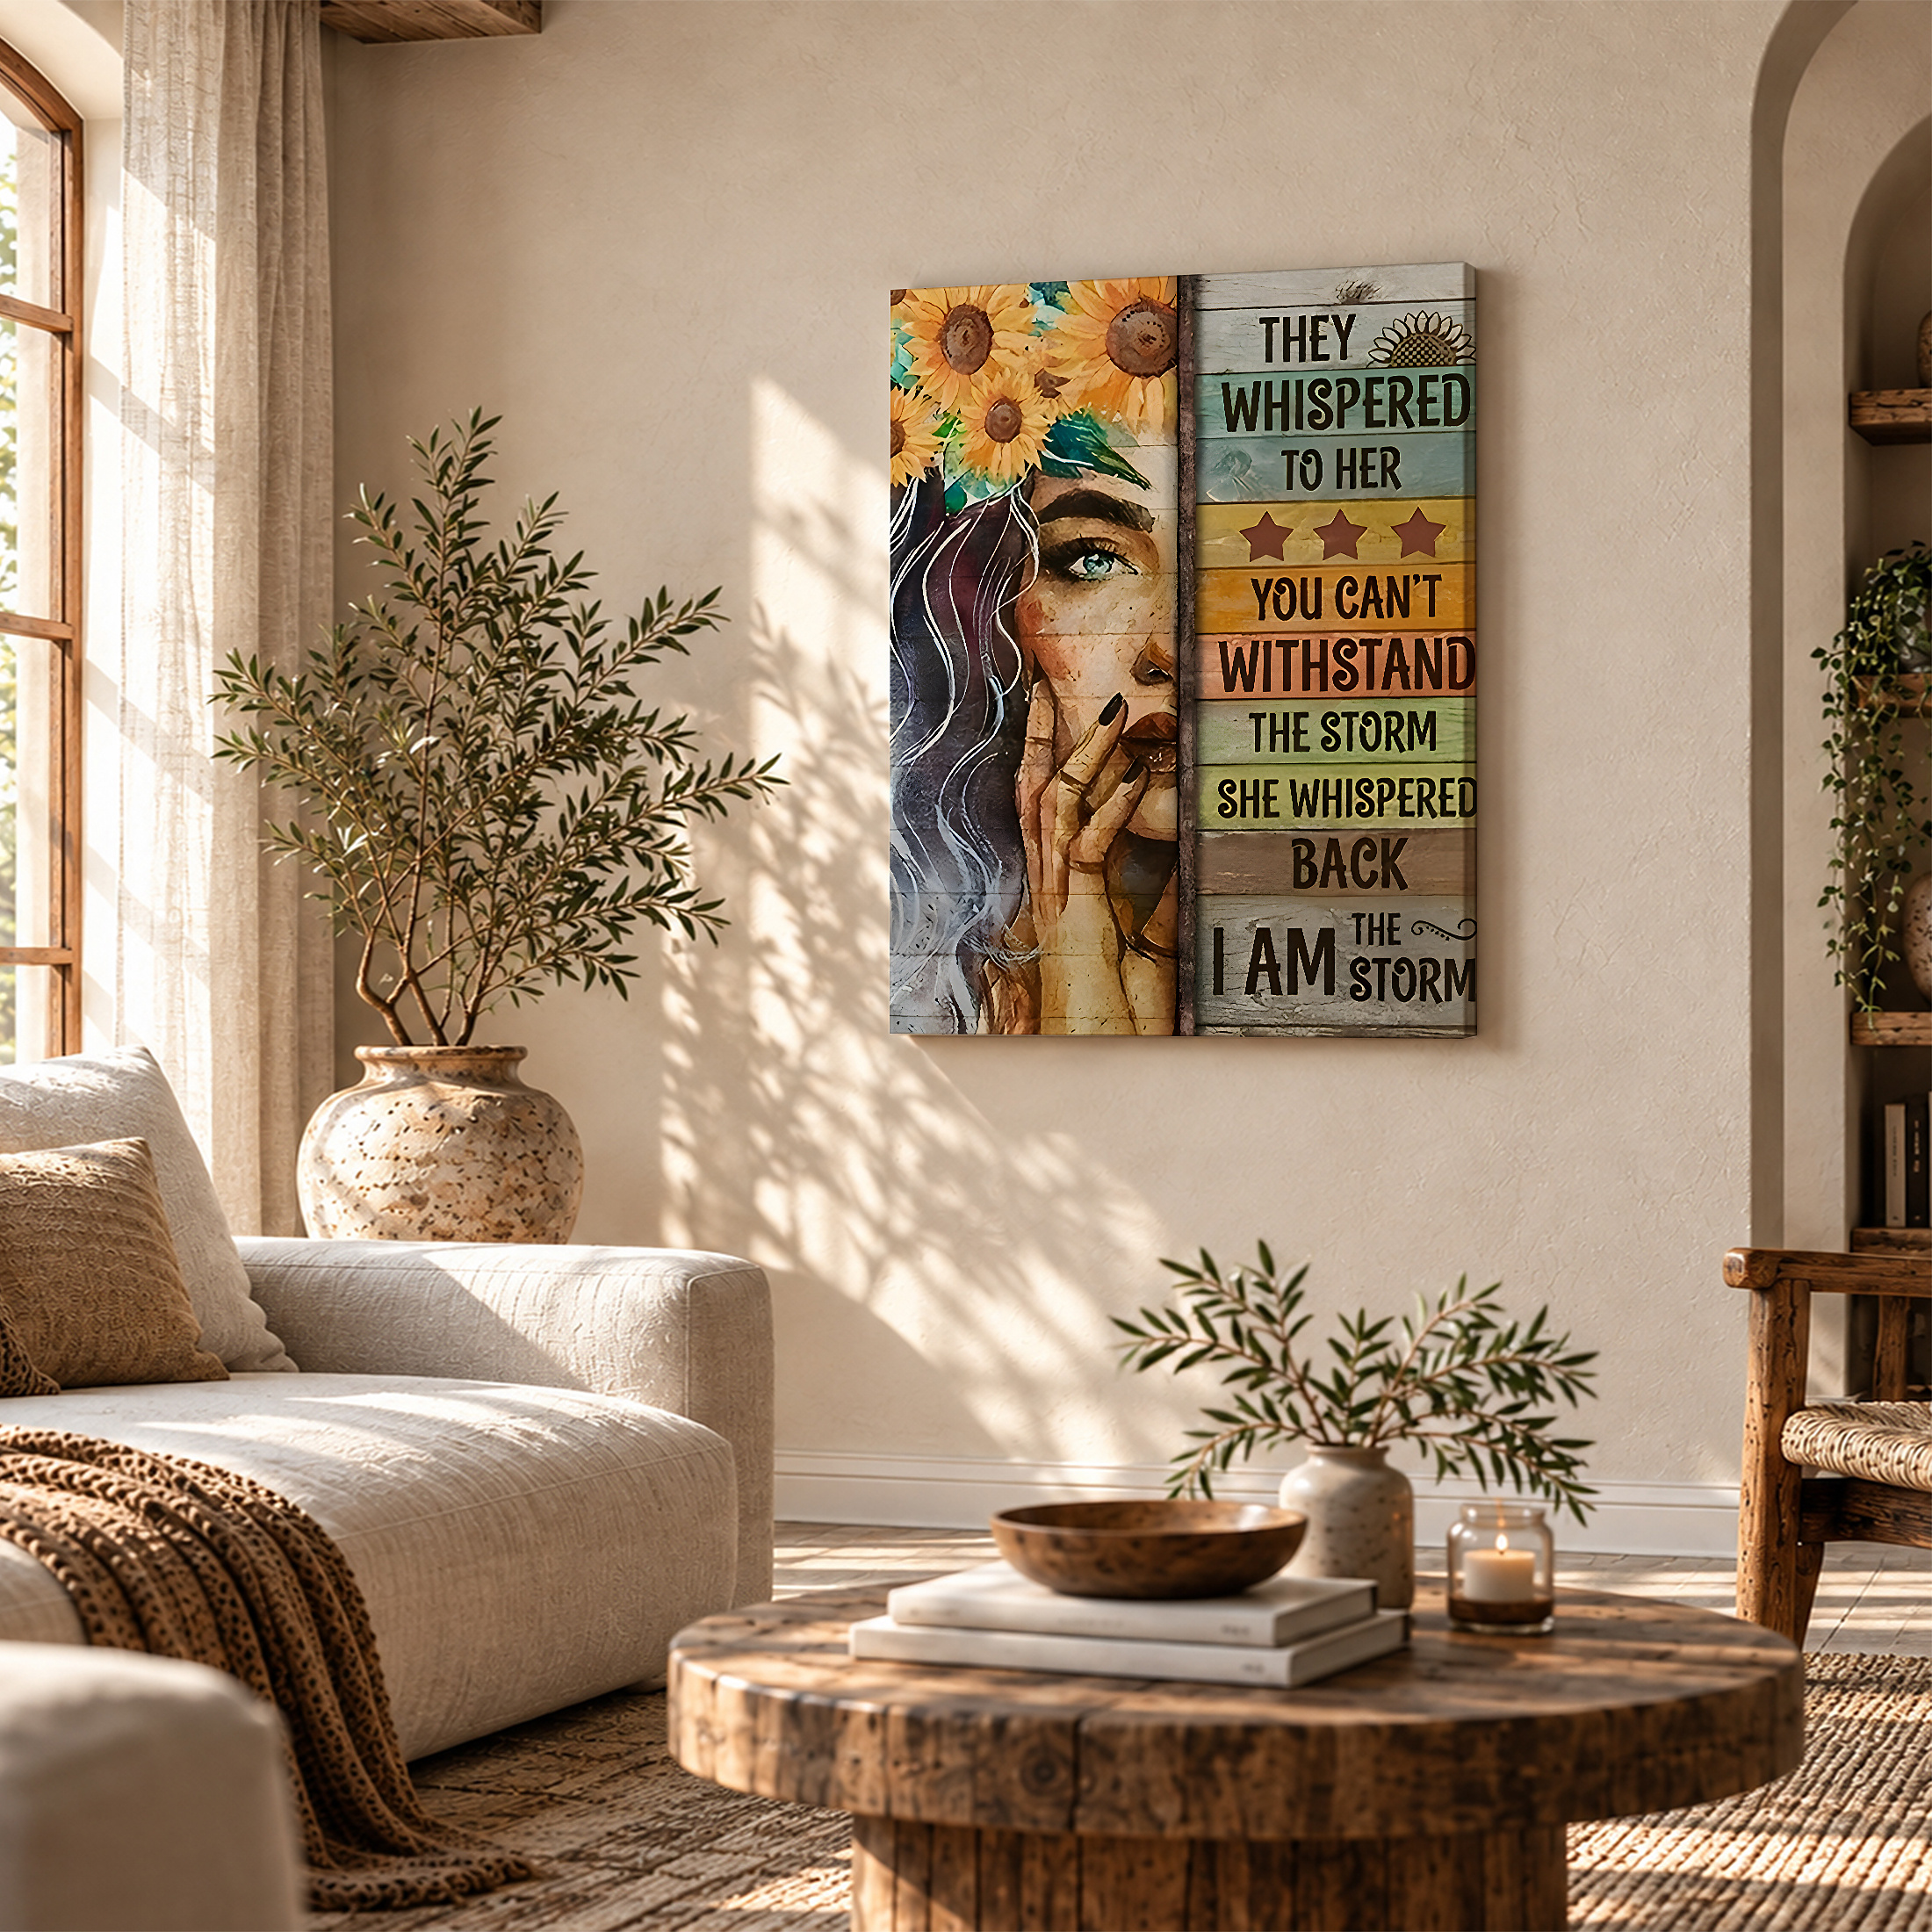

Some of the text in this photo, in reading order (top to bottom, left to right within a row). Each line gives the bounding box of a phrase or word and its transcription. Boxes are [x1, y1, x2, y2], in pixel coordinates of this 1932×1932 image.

[1258, 314, 1357, 363] THEY
[1221, 372, 1471, 433] WHISPERED
[1280, 445, 1402, 491] TO HER
[1251, 573, 1442, 621] YOU CAN'T
[1218, 637, 1476, 693] WITHSTAND
[1249, 710, 1437, 753] THE STORM
[1217, 777, 1477, 819] SHE WHISPERED
[1291, 837, 1409, 891] BACK
[1351, 912, 1401, 946] THE
[1212, 926, 1337, 996] I AM
[1349, 955, 1476, 1004] STORM
